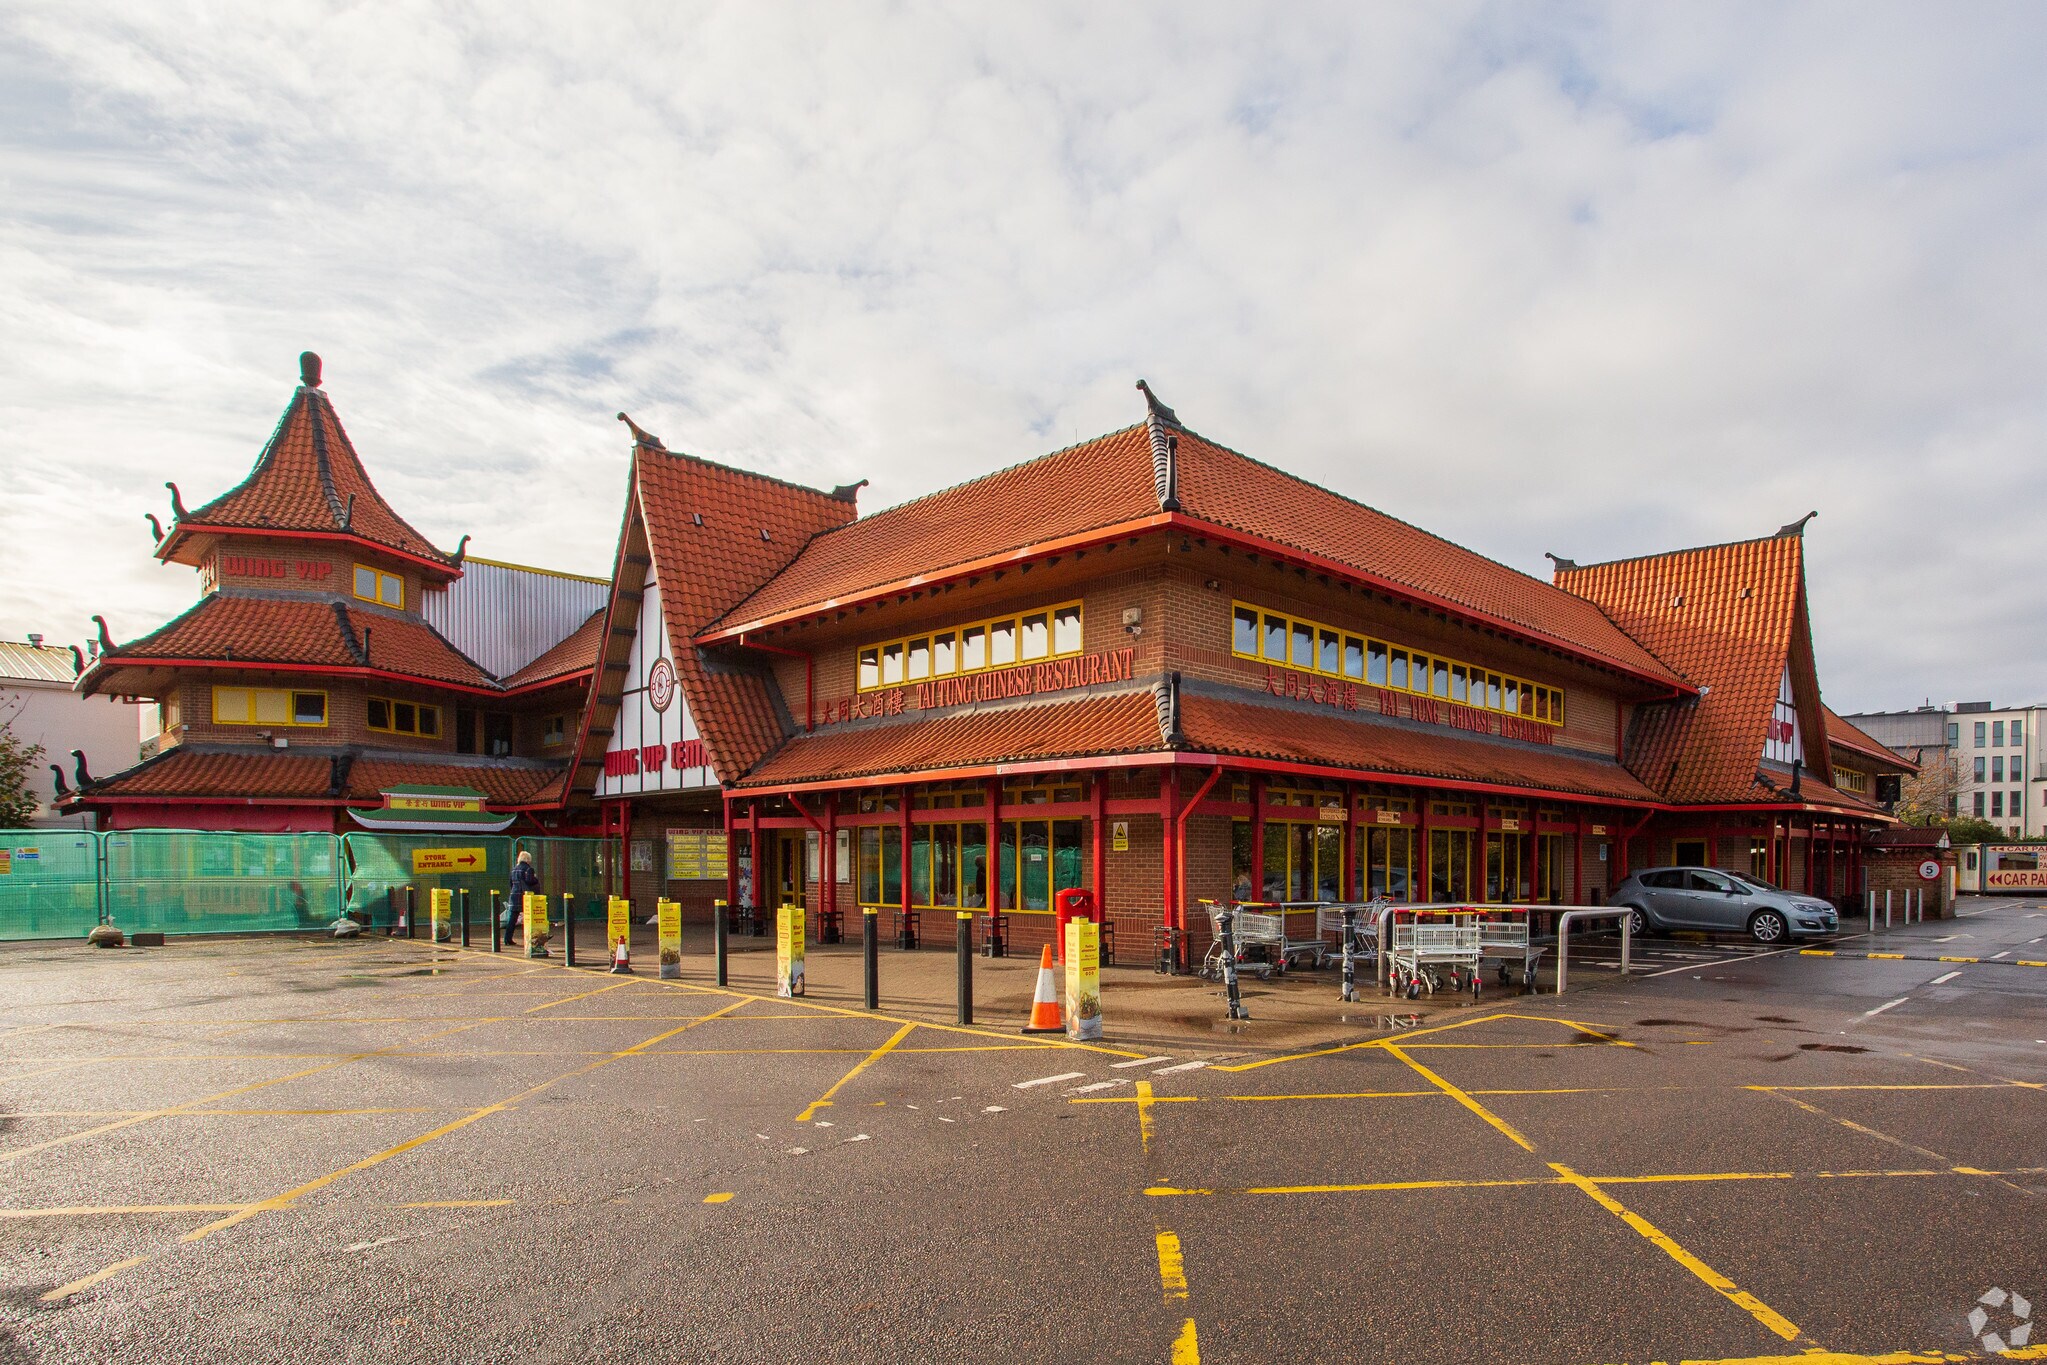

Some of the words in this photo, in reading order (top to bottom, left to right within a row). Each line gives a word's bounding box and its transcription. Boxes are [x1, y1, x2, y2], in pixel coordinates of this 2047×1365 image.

[224, 556, 284, 578] WING
[295, 561, 332, 580] YIP
[917, 681, 937, 709] TAI
[938, 676, 972, 708] TUNG
[975, 665, 1032, 702] CHINESE
[1036, 648, 1134, 693] RESTAURANT
[1264, 665, 1359, 712] 大同大酒樓
[822, 688, 905, 725] 大同大酒樓
[1379, 689, 1400, 717] TAI
[1410, 696, 1440, 725] TUNG
[1450, 704, 1493, 735] CHINESE
[1501, 715, 1555, 745] RESTAURANT
[604, 748, 639, 777] WING
[642, 744, 666, 772] YIP
[430, 800, 451, 808] WING
[453, 801, 466, 809] YIP
[1926, 865, 1934, 875] 5
[2004, 873, 2027, 885] CAR
[2031, 873, 2047, 885] PA
